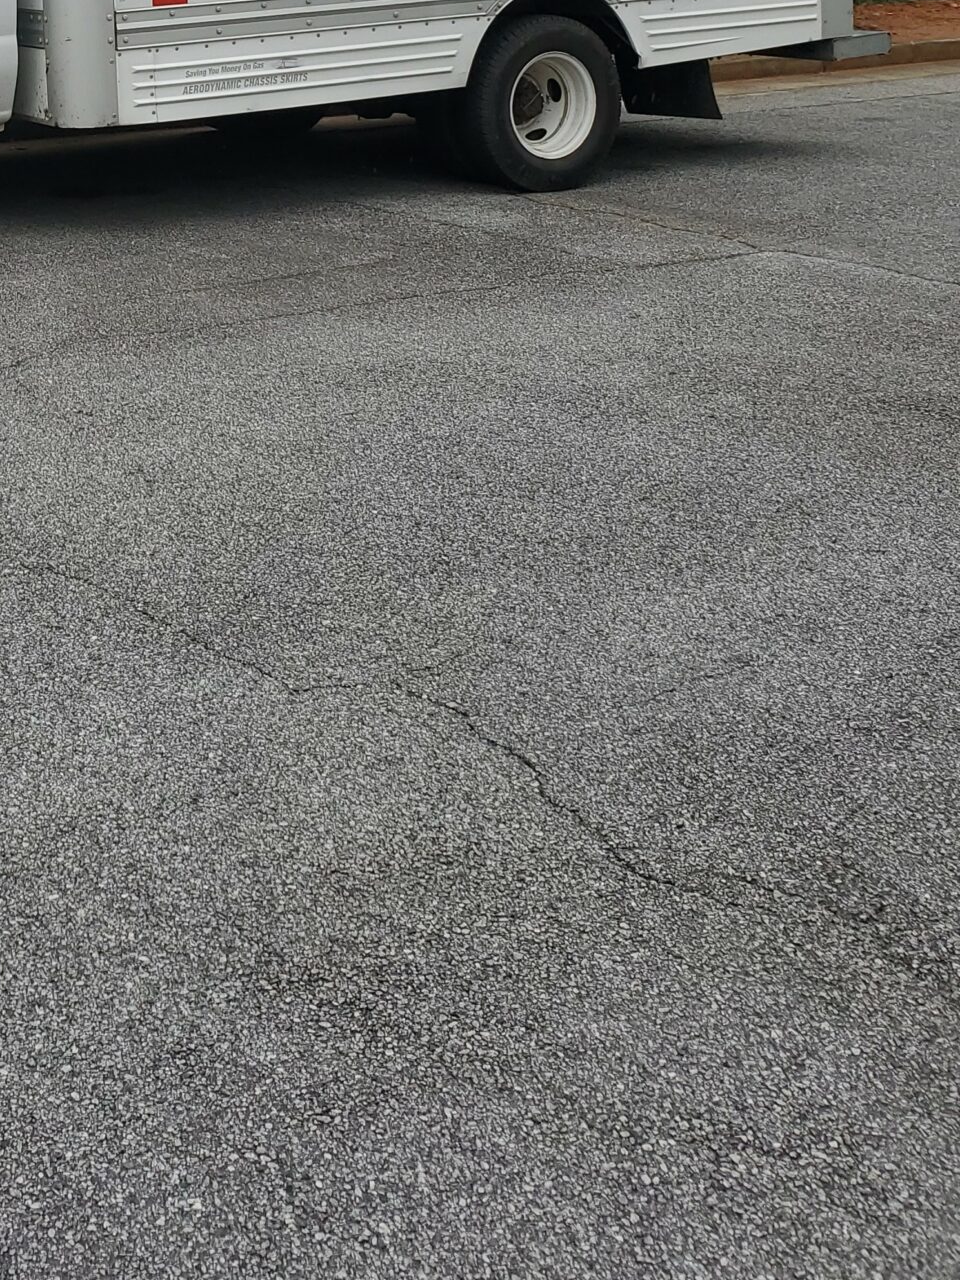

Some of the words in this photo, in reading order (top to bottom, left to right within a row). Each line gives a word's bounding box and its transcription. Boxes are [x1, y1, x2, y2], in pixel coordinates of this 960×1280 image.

[185, 69, 207, 78] Saving
[208, 67, 220, 76] You
[220, 64, 242, 75] Money
[243, 62, 252, 71] On
[253, 61, 264, 70] Gas
[182, 80, 242, 95] AERODYNAMIC
[243, 75, 278, 88] CHASSIS
[280, 72, 308, 84] SKIRTS
